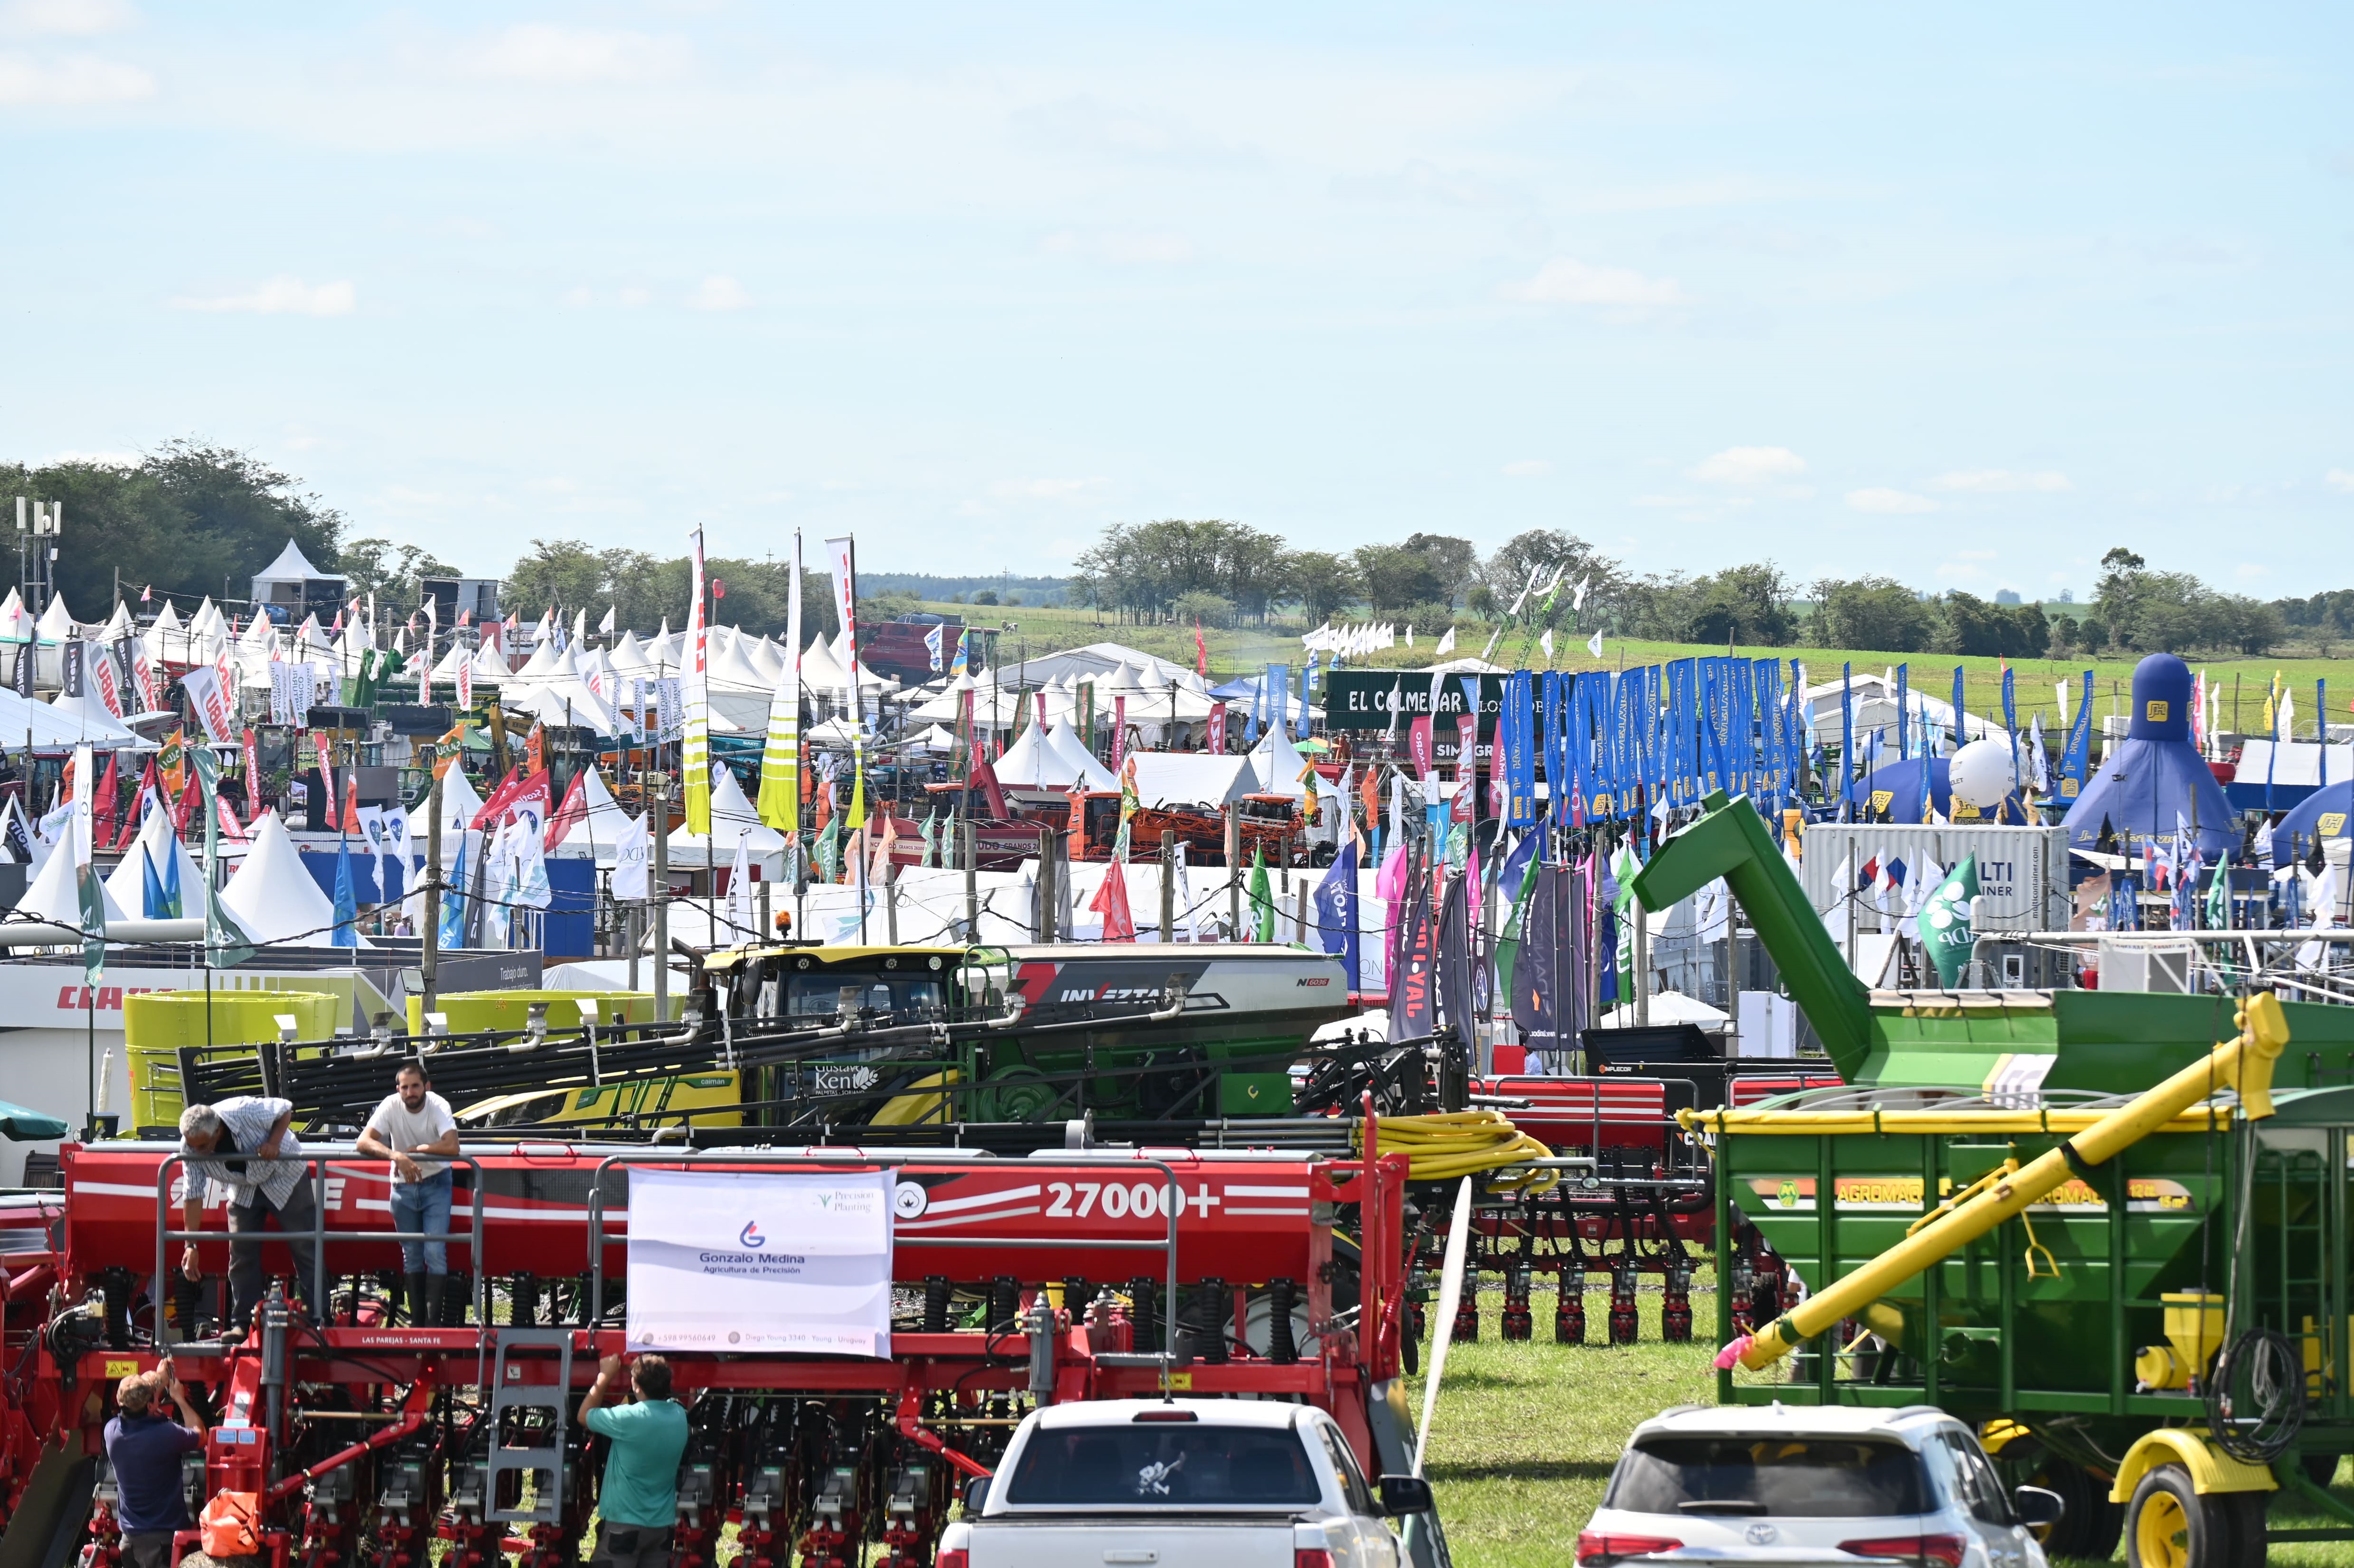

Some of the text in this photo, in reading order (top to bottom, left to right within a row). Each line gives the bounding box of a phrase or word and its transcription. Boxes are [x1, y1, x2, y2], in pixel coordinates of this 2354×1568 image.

[1349, 691, 1368, 711] EL
[500, 964, 528, 982] Trabajo duro.
[835, 1190, 874, 1200] Precision
[1045, 1182, 1221, 1218] 27000+
[1836, 1184, 1922, 1204] AGROMAQ
[834, 1202, 872, 1213] Planting
[699, 1252, 805, 1264] Gonzalo Medina
[703, 1265, 801, 1274] Agricultura de Precisión
